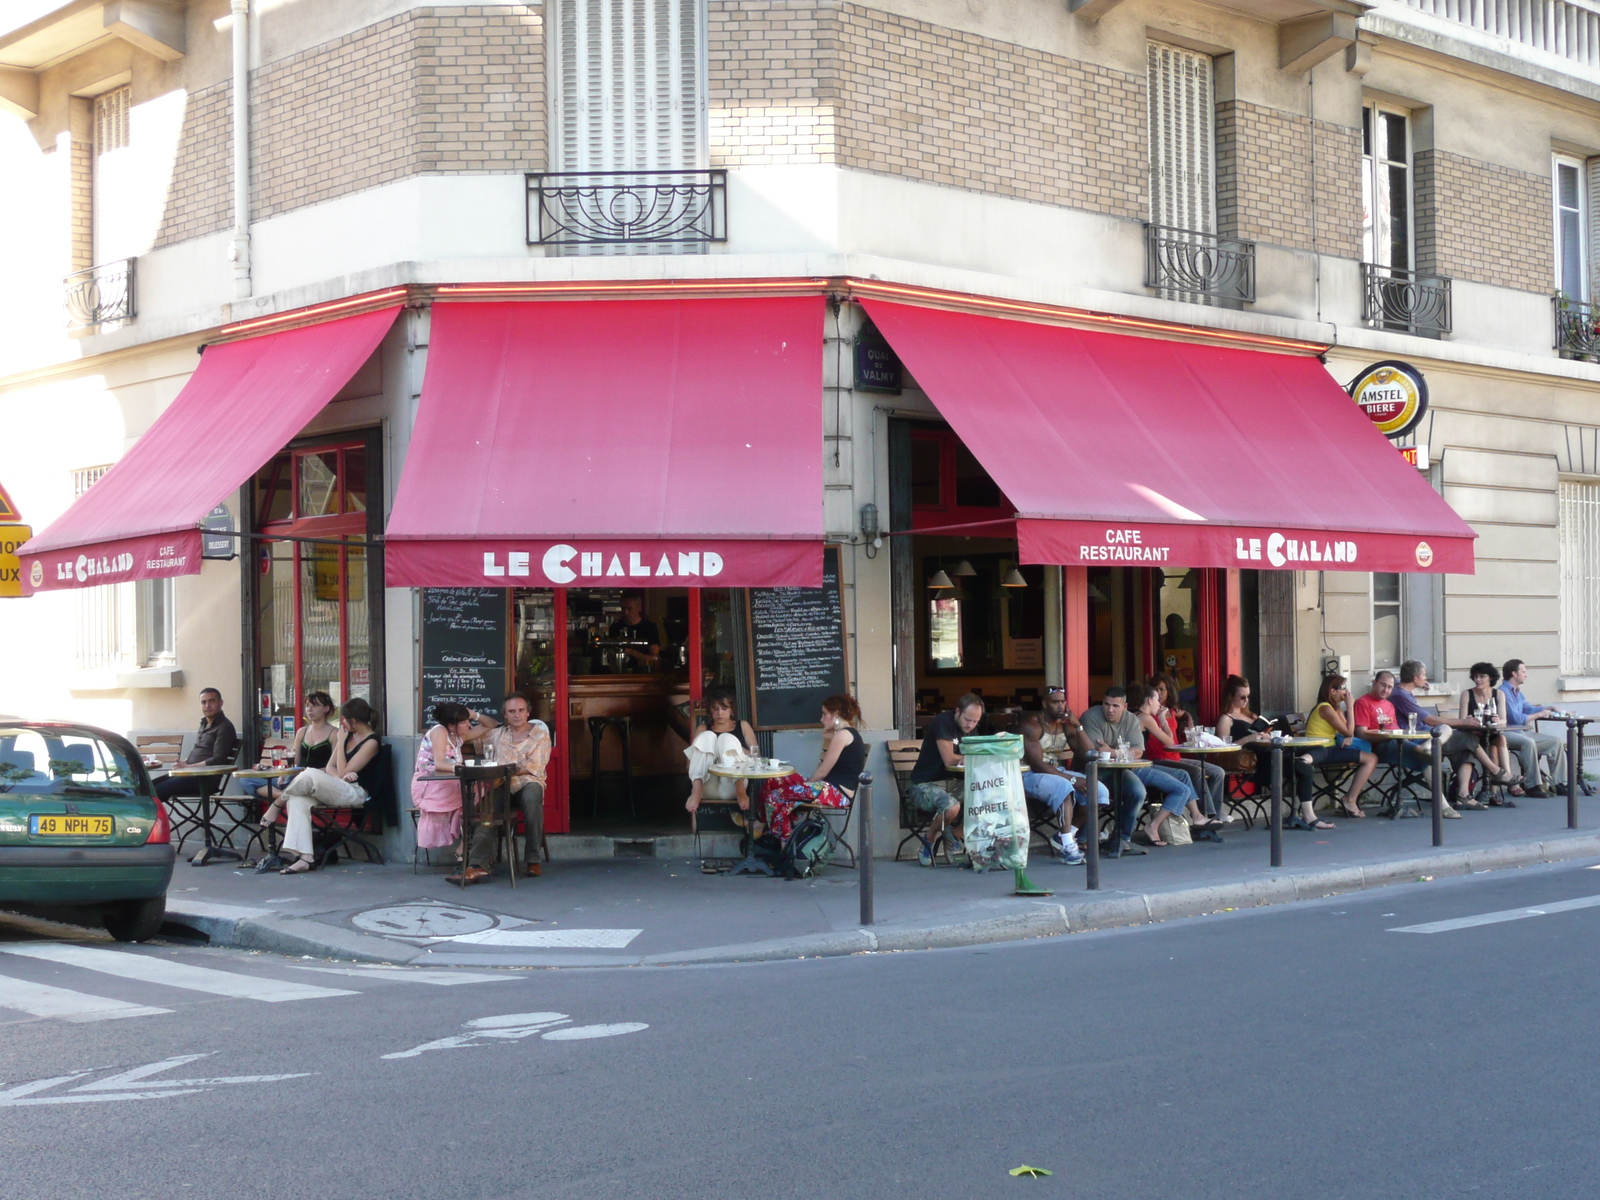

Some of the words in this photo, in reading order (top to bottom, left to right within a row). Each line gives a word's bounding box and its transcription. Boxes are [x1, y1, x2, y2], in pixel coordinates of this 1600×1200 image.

[867, 349, 889, 361] QUAI
[862, 369, 895, 382] VALMY
[1361, 389, 1403, 403] AMSTEL
[1366, 403, 1396, 413] BIERE
[1105, 529, 1142, 545] CAFE
[159, 546, 175, 557] CAFE
[1079, 545, 1170, 562] RESTAURANT
[1235, 537, 1262, 560] LE
[1266, 532, 1358, 568] CHALAND
[57, 561, 73, 580] LE
[75, 552, 134, 583] CHALAND
[146, 556, 187, 570] RESTAURANT
[483, 552, 530, 577] LE
[542, 543, 724, 584] CHALAND
[40, 818, 57, 832] 49
[64, 818, 89, 833] NPH
[93, 818, 109, 833] 75
[126, 826, 142, 834] Clio
